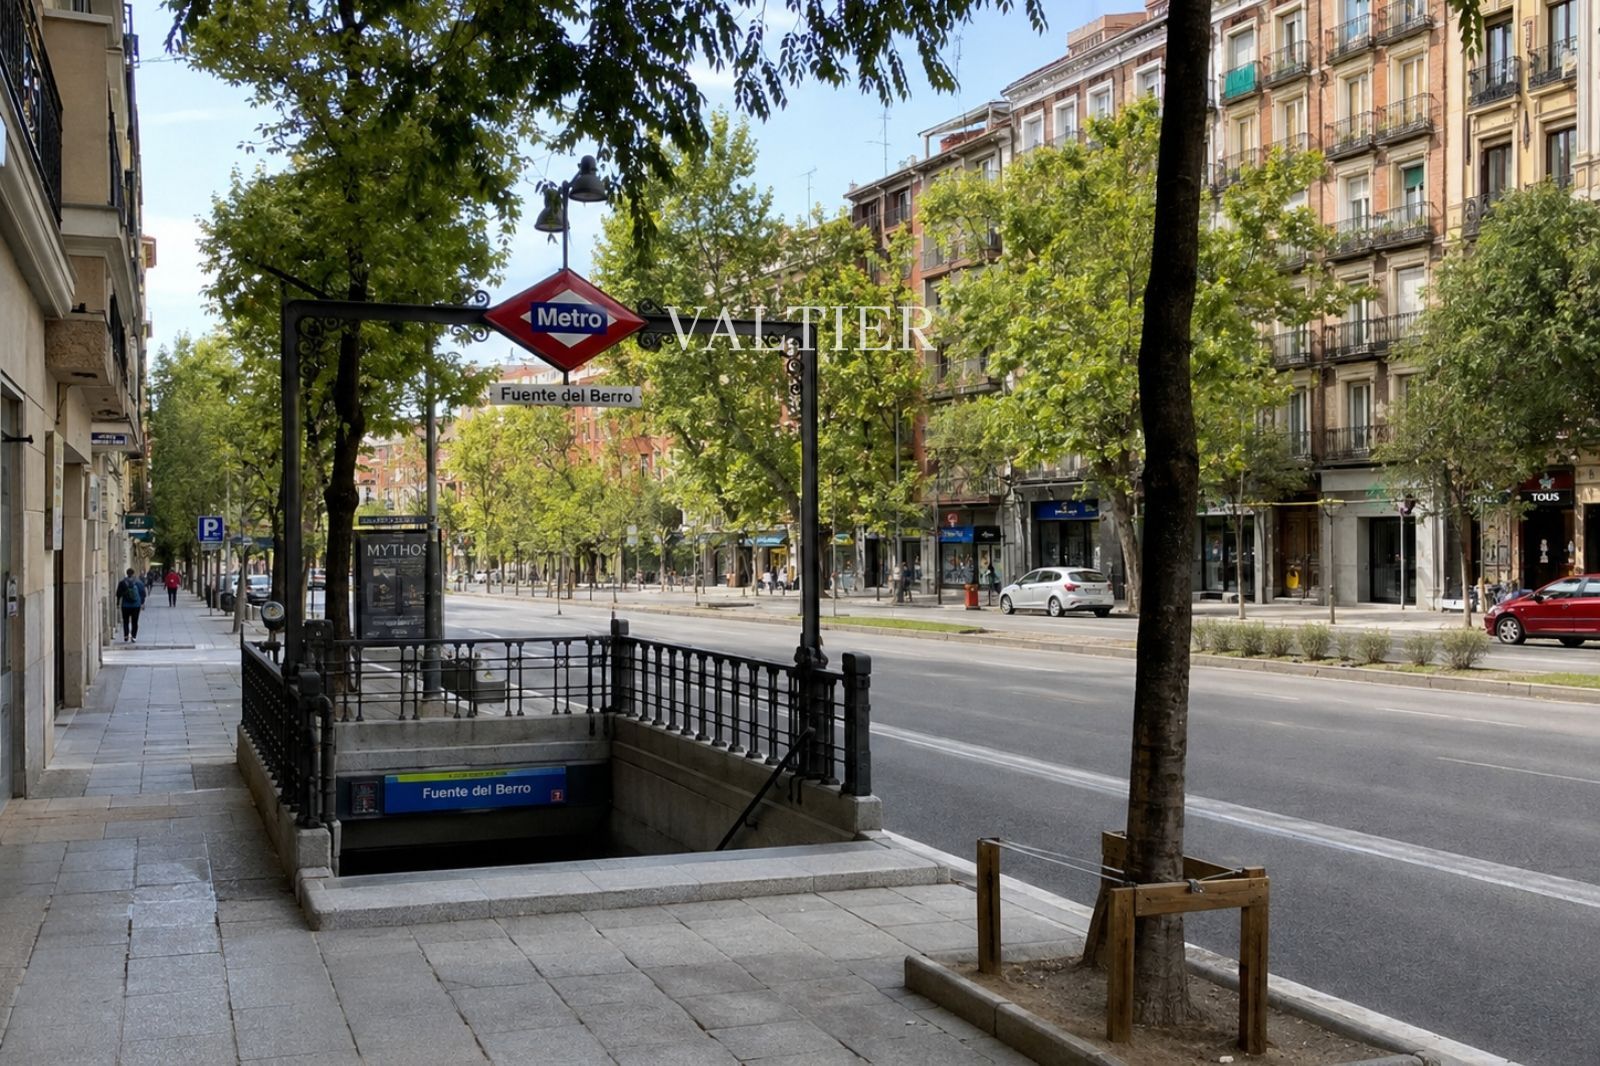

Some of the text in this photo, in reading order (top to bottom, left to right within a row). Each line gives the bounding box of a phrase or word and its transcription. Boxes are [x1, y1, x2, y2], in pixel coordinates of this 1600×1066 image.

[537, 307, 602, 329] Metro
[501, 387, 632, 403] Fuente del Berro
[1531, 492, 1560, 502] TOUS
[203, 519, 219, 537] P
[422, 783, 532, 799] Fuente del Berro
